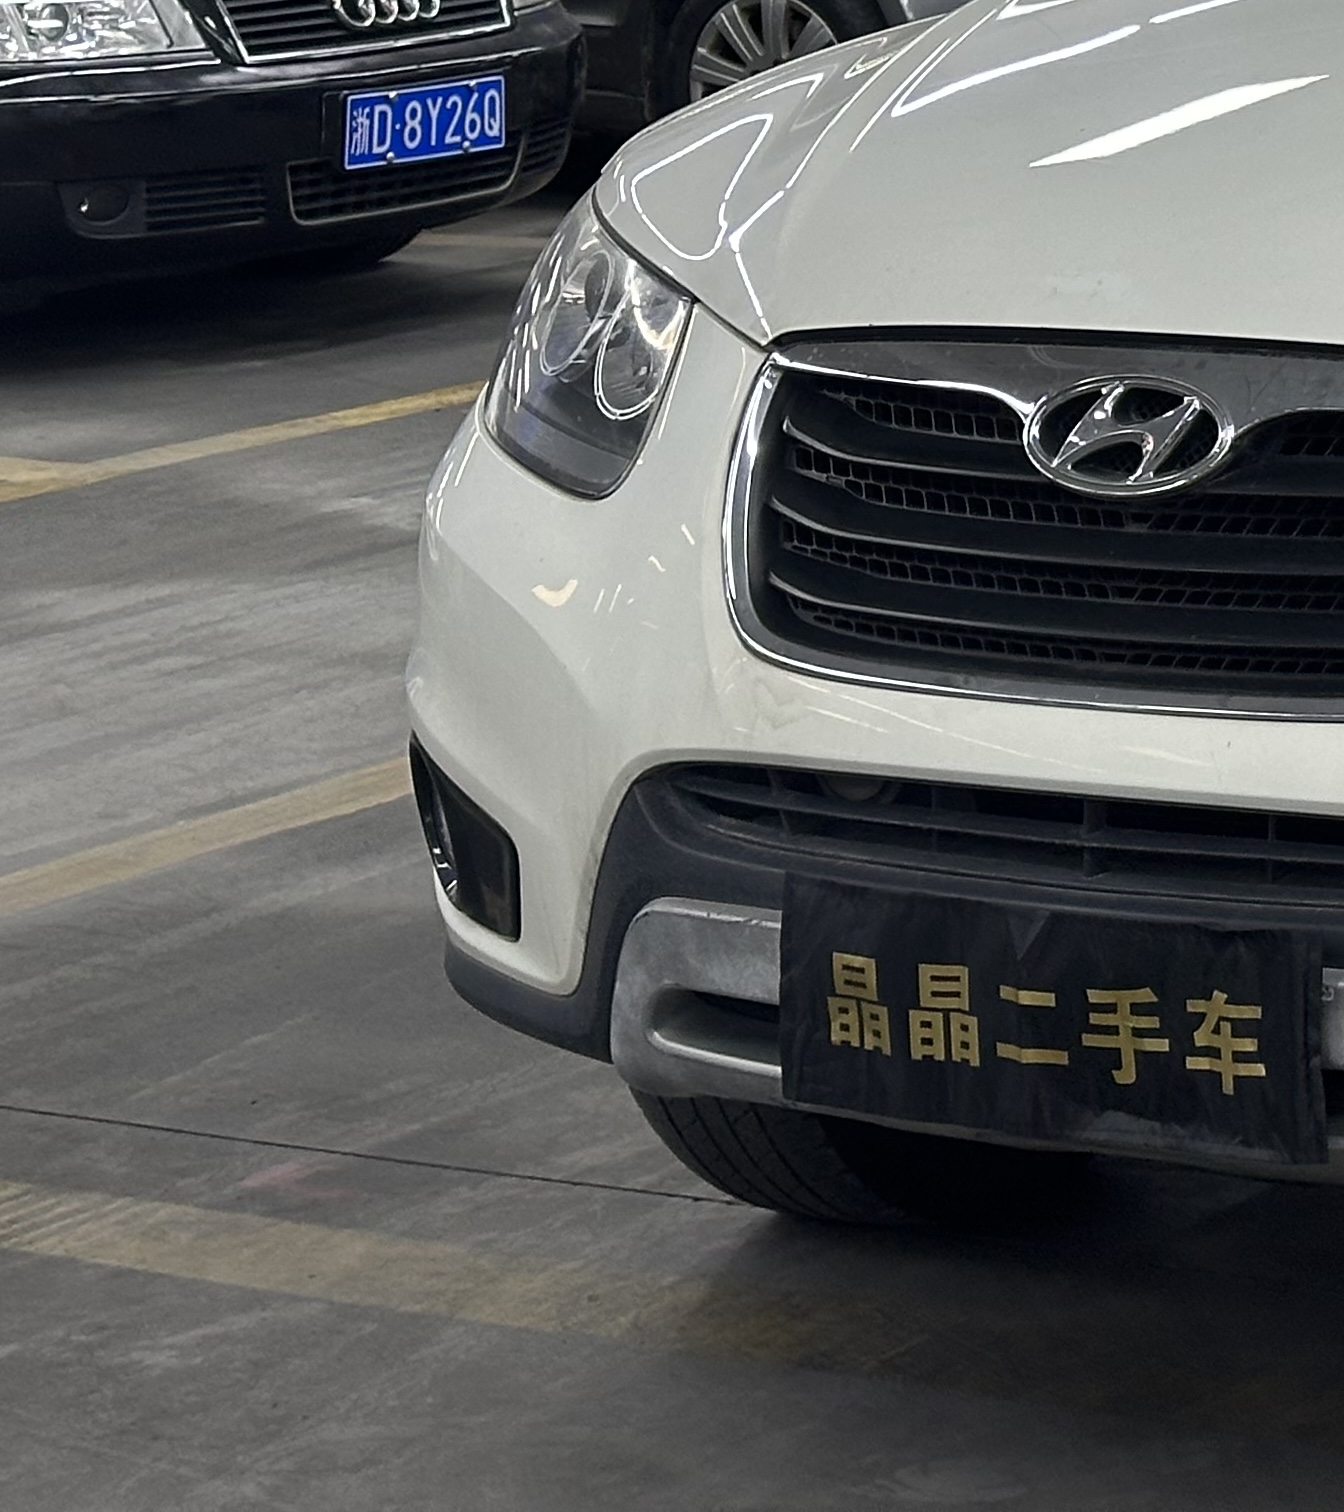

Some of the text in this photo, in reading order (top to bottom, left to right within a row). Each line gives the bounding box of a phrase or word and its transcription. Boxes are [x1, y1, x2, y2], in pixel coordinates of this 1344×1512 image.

[827, 951, 1266, 1094] 晶晶二手车
